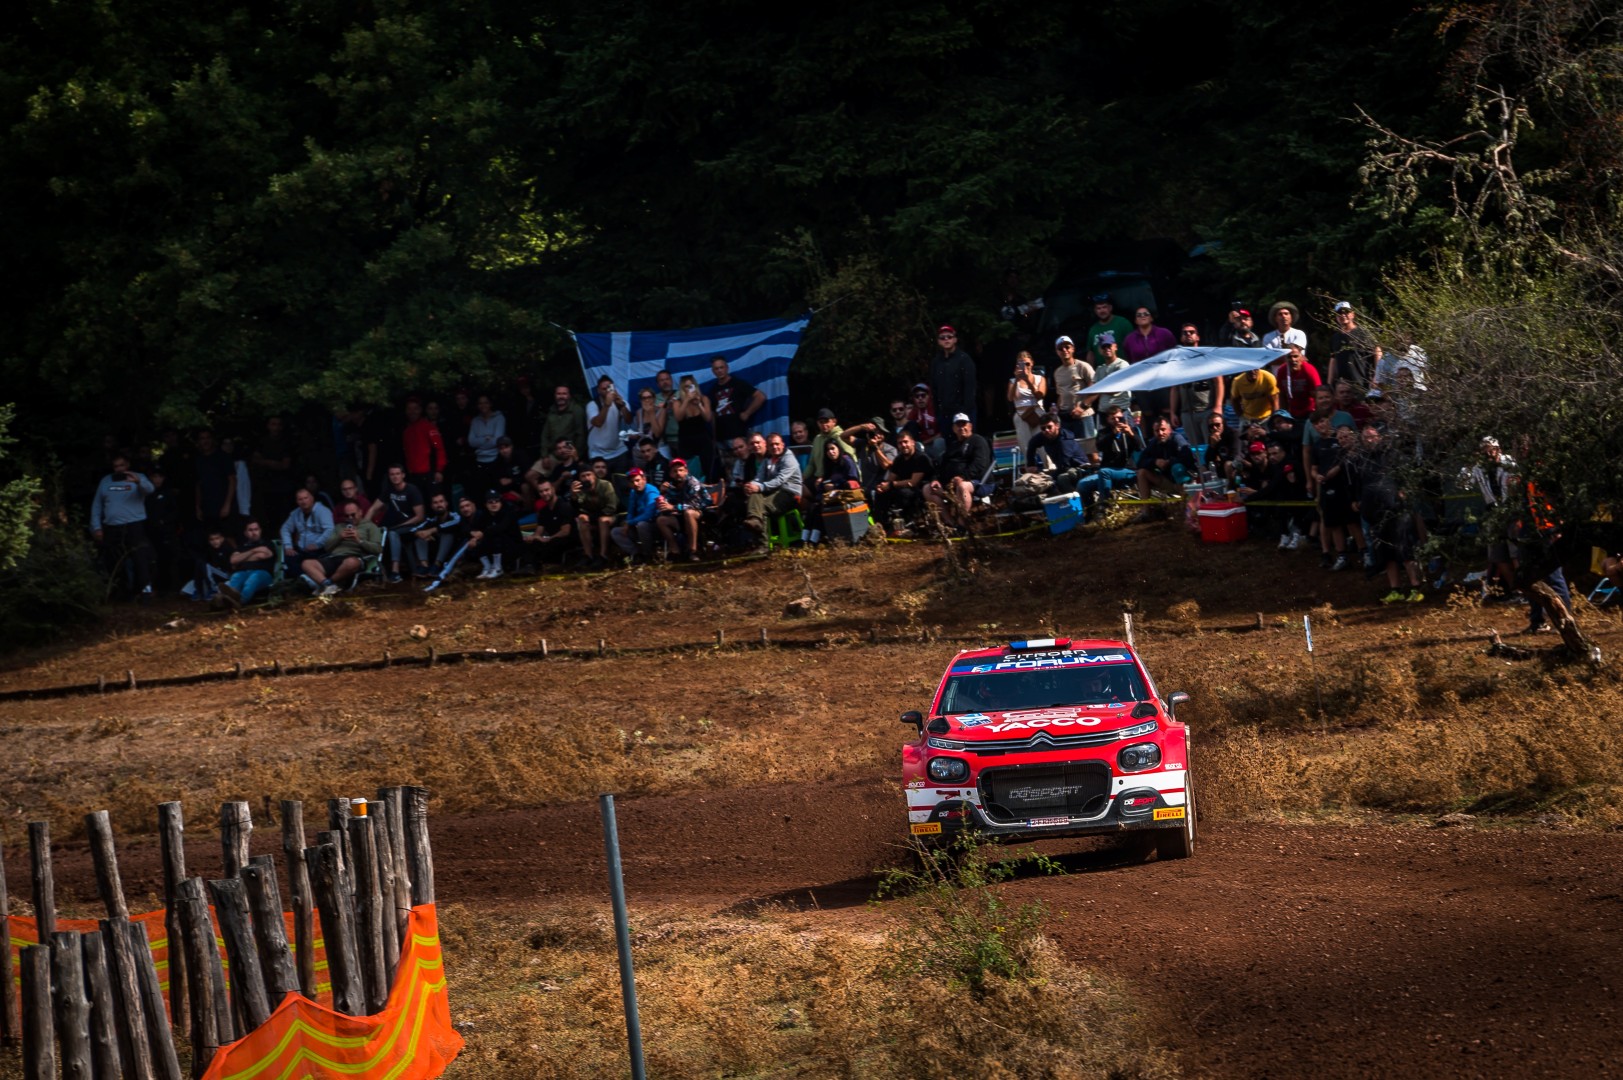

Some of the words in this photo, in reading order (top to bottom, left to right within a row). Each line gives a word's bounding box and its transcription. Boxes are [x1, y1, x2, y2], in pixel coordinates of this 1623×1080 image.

[996, 655, 1126, 669] FORUM8
[984, 717, 1101, 733] YACCO
[1157, 809, 1182, 819] PIRELLI
[913, 824, 939, 834] PIRELLI
